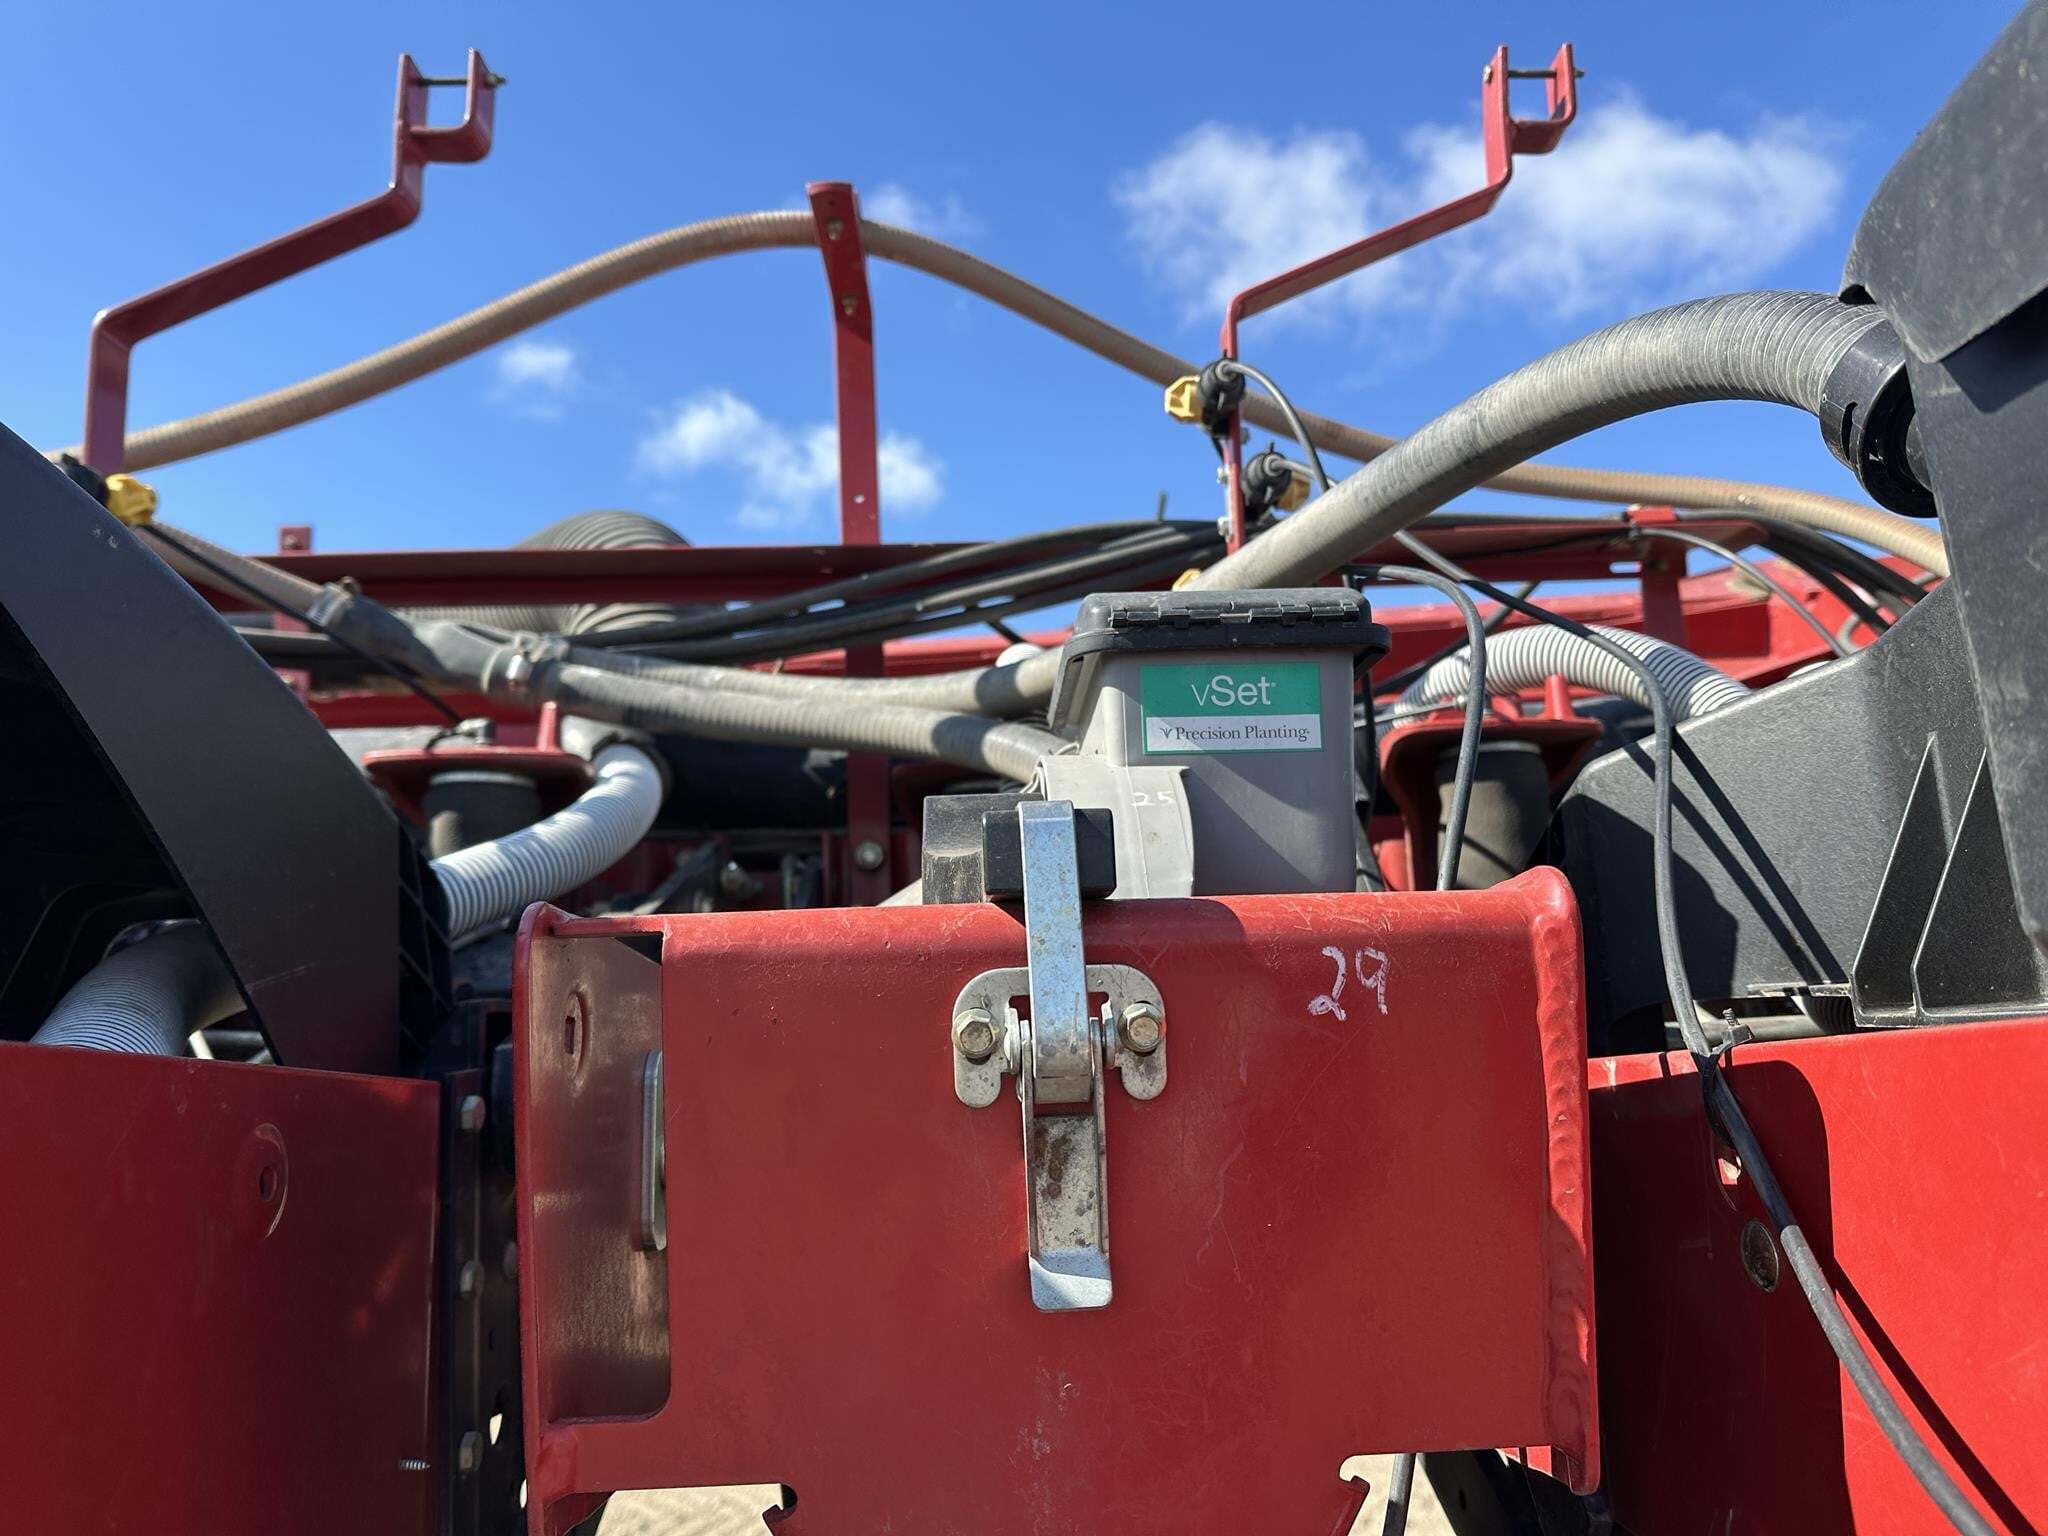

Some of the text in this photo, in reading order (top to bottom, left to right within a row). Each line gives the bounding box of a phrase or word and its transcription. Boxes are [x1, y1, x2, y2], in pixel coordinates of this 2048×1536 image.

[1191, 675, 1272, 706] vSet
[1176, 725, 1307, 742] Precision Planting
[1131, 791, 1175, 806] 25
[1307, 945, 1390, 1021] 29
